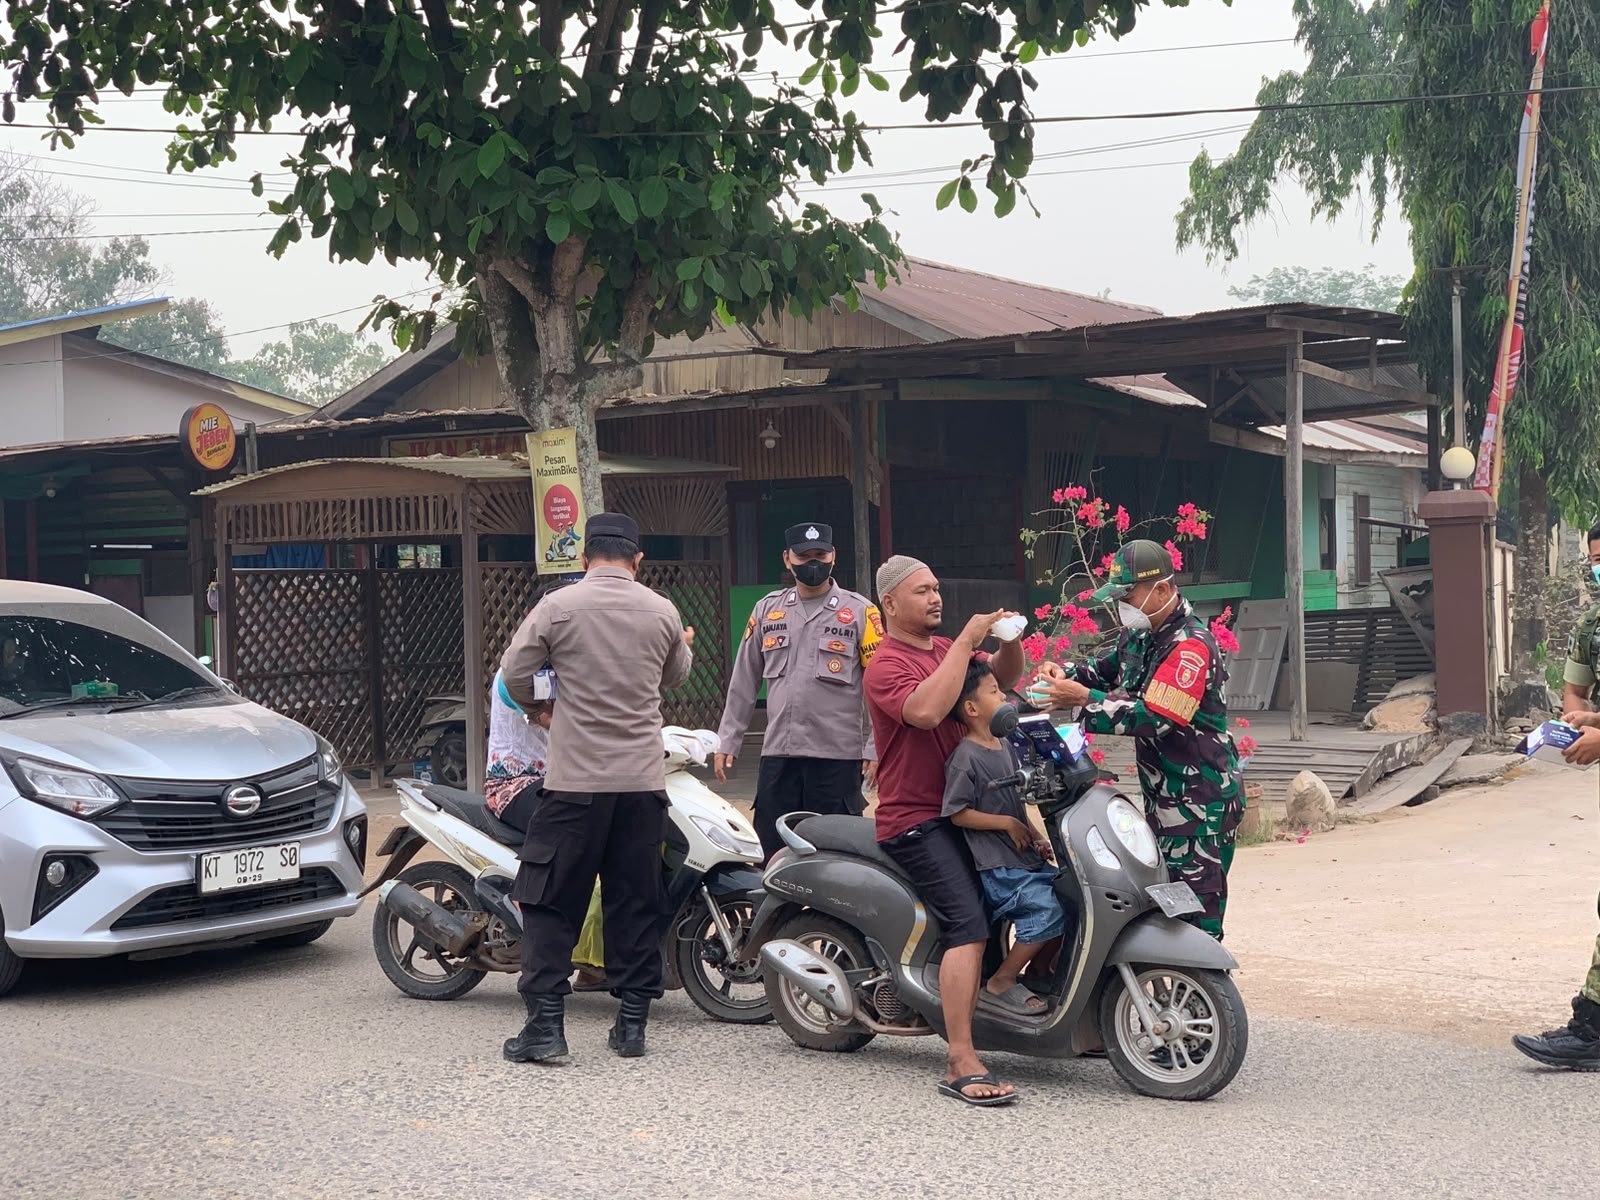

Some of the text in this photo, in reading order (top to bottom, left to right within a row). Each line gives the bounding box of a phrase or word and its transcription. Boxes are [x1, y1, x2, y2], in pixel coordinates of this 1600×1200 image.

[200, 417, 219, 433] MIE
[195, 426, 230, 456] JEBEW
[542, 437, 566, 448] maxim
[544, 455, 567, 465] Pesan
[536, 465, 578, 477] MaximBike
[824, 626, 854, 638] POLRI
[204, 857, 221, 879] KT
[233, 851, 265, 874] 1972
